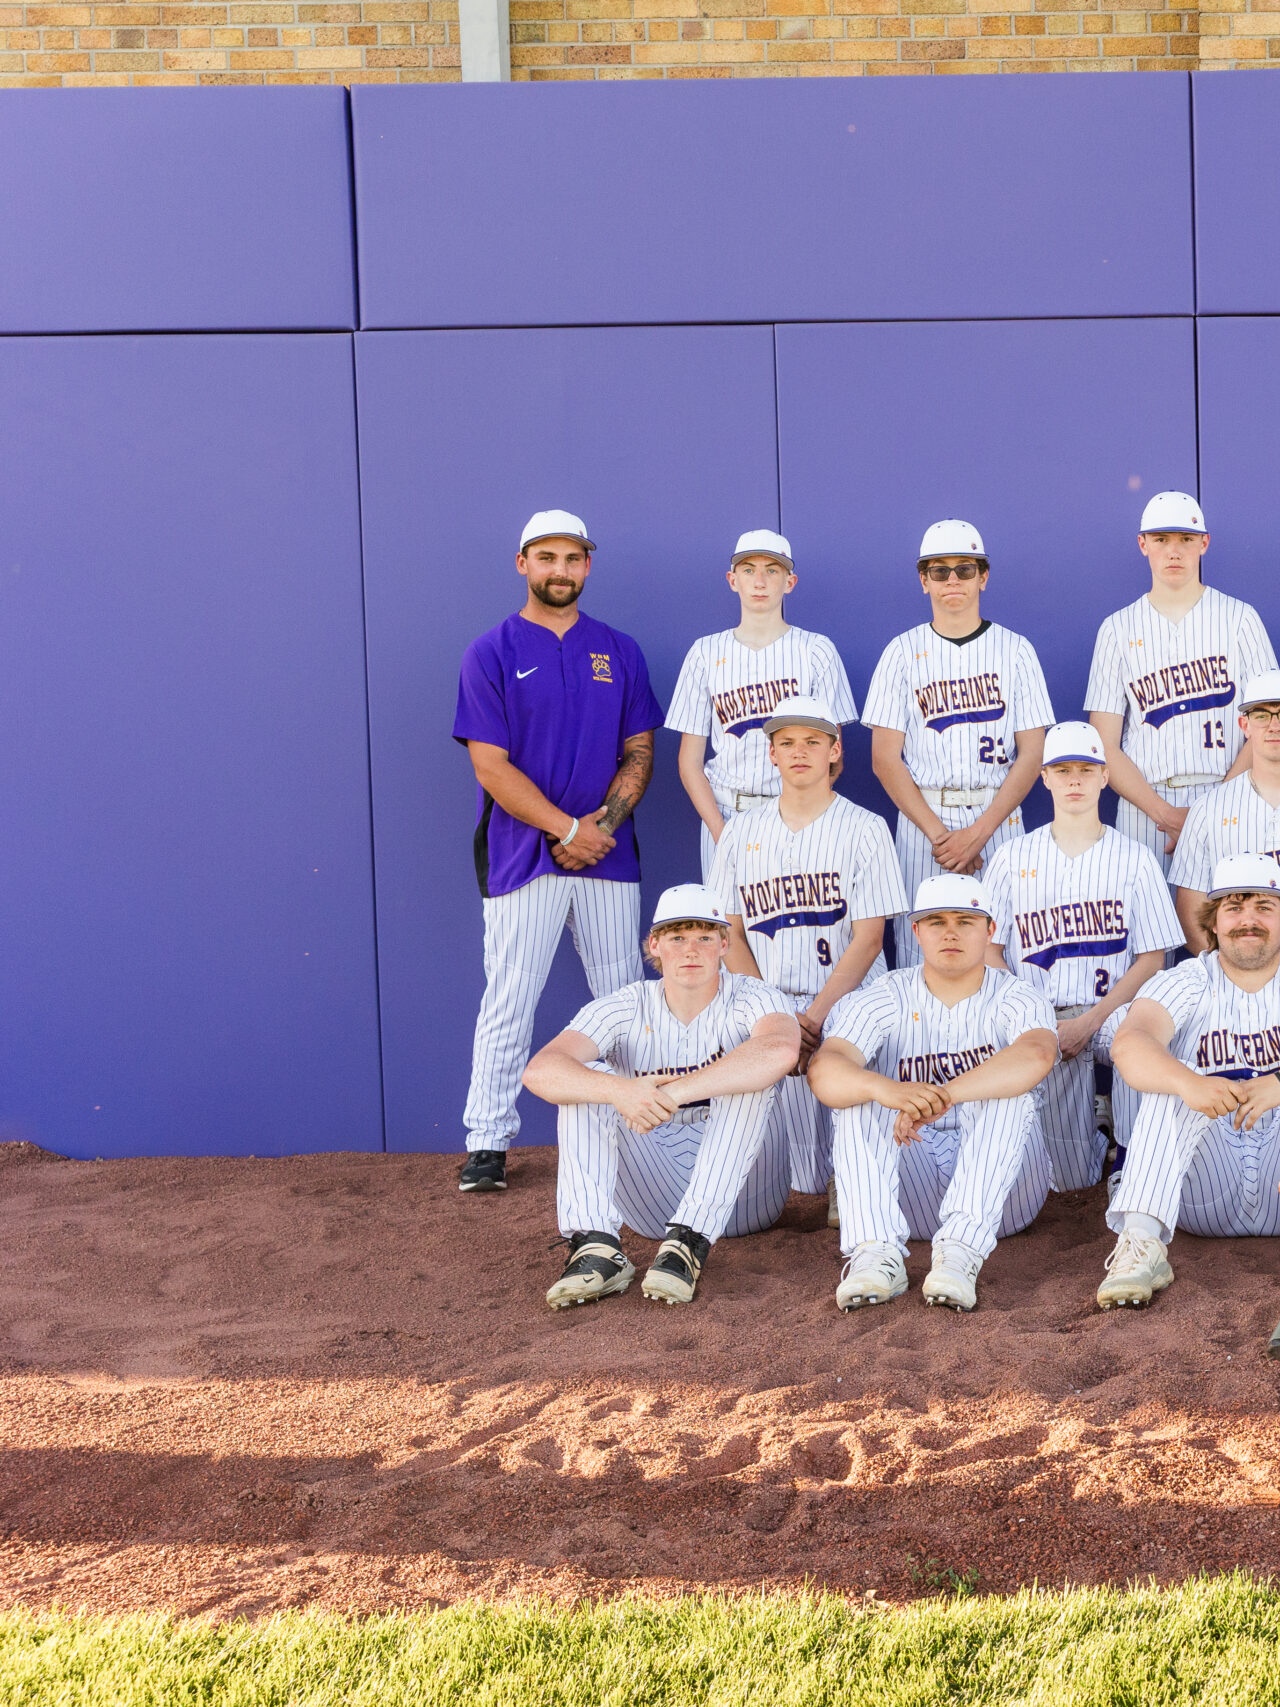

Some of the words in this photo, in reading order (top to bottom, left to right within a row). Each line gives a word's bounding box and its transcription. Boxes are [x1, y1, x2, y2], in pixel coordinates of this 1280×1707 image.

[914, 673, 1001, 719] WOLVERINES
[1129, 655, 1228, 712] WOLVERINES
[1203, 720, 1226, 749] 13
[979, 736, 1009, 765] 23
[1015, 900, 1124, 949] WOLVERINES
[816, 938, 832, 967] 9
[1095, 968, 1110, 997] 2
